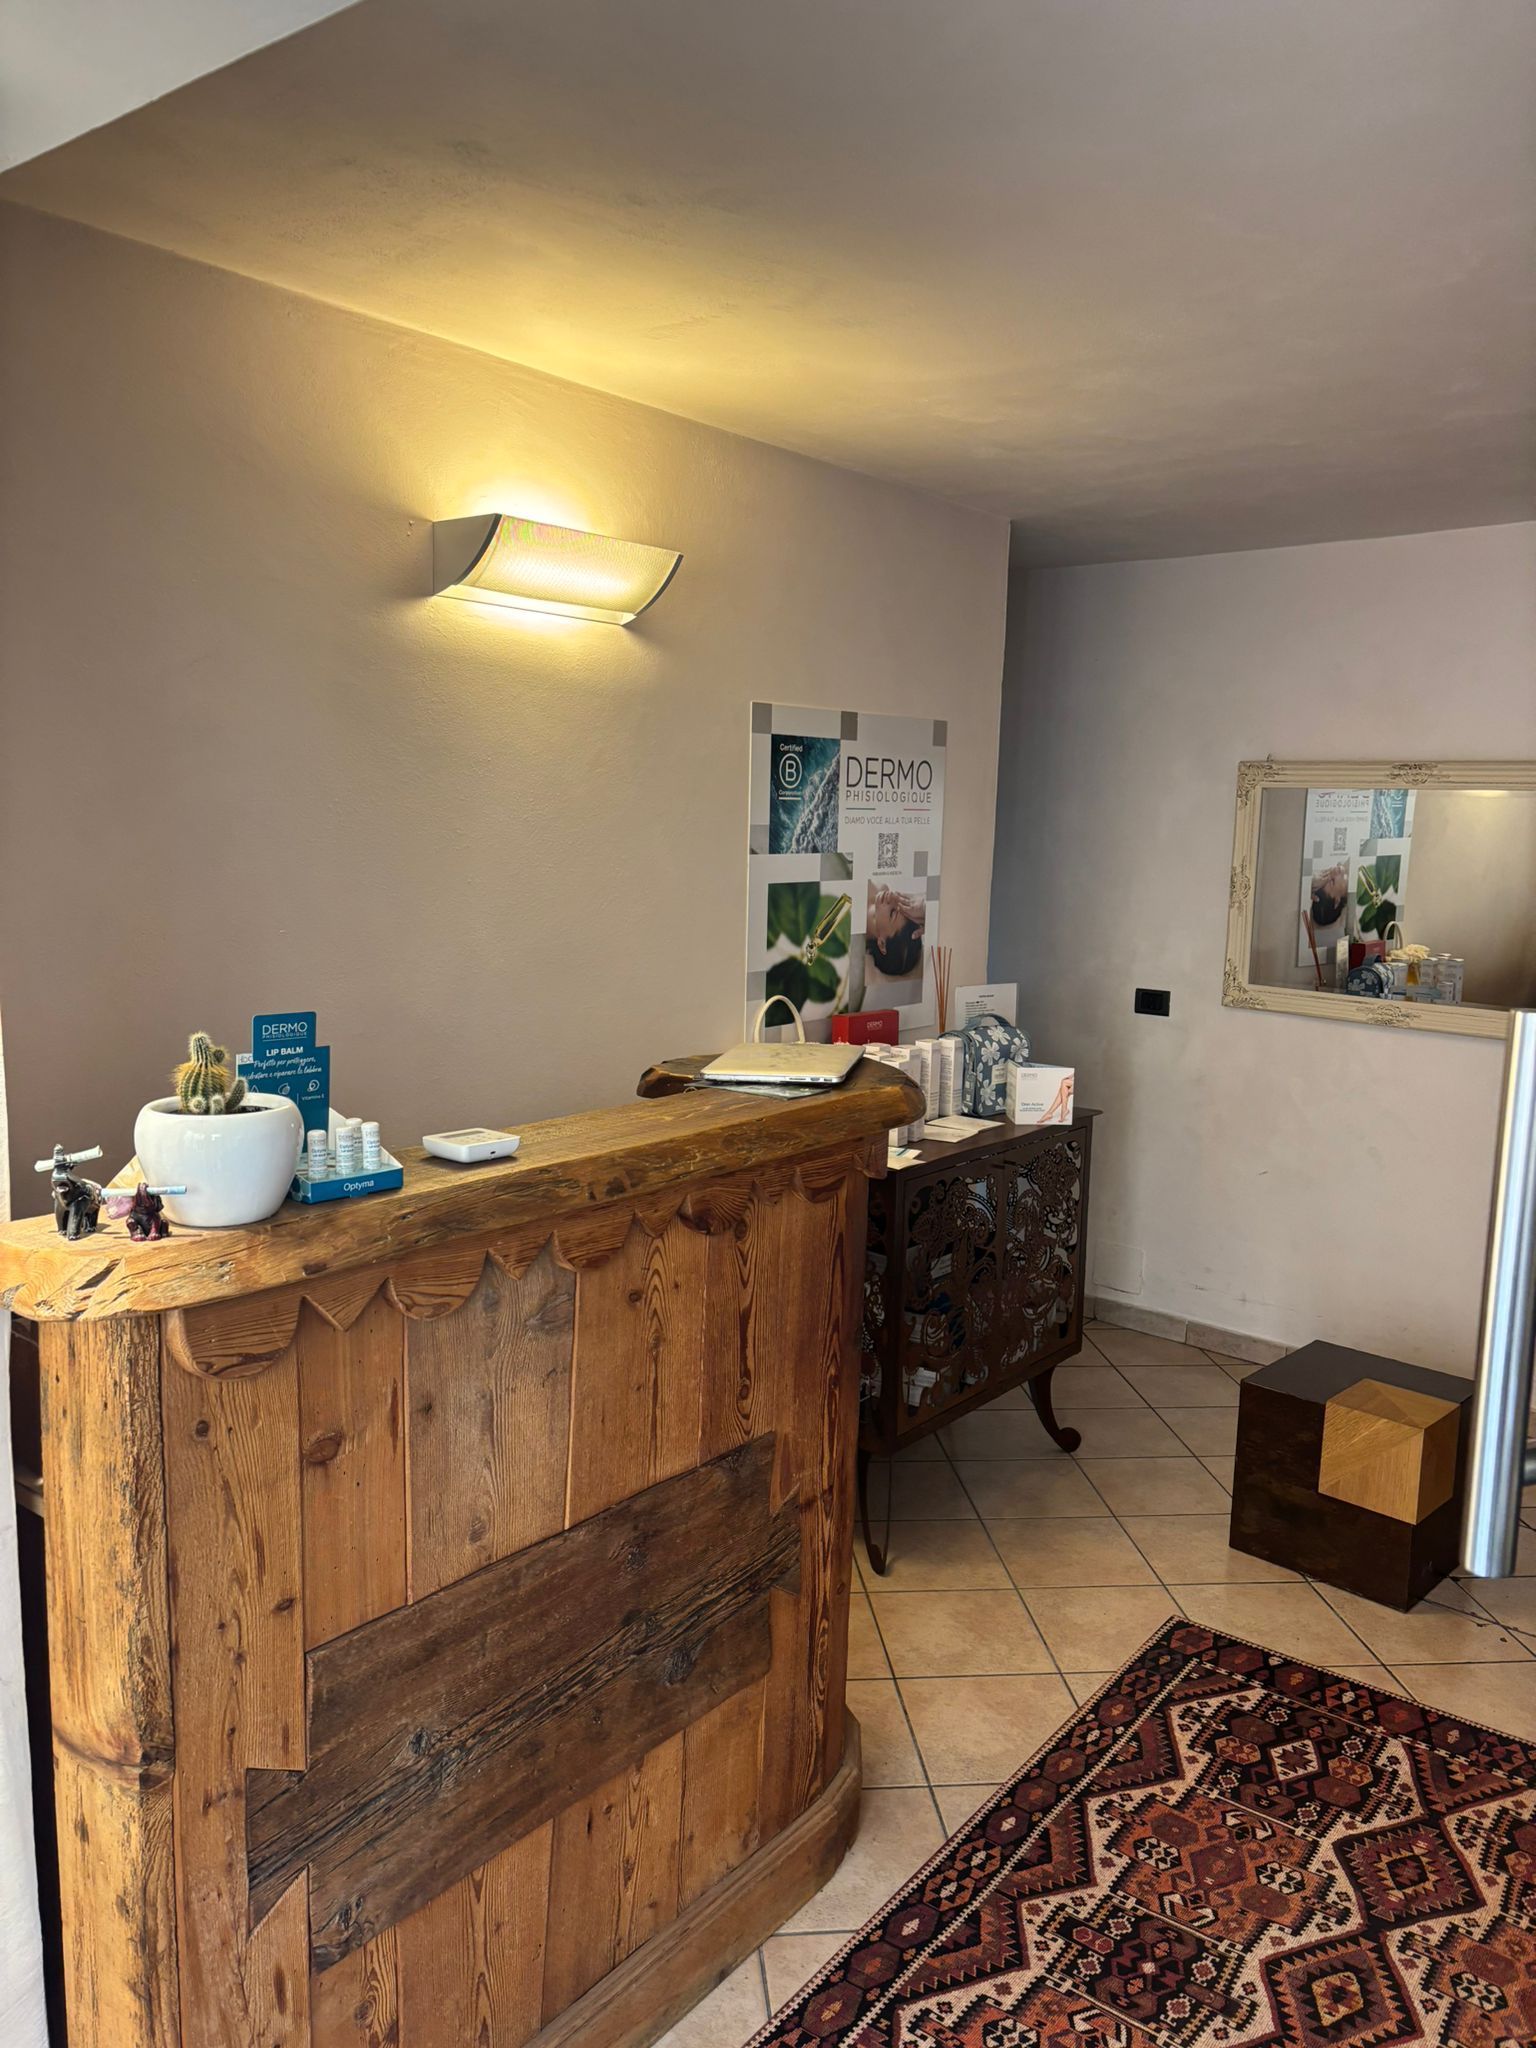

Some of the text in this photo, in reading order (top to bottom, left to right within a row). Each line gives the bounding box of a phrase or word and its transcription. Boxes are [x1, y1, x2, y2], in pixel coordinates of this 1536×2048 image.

[780, 743, 803, 752] Certified
[785, 760, 797, 781] B
[846, 756, 933, 790] DERMO
[845, 790, 932, 803] PHISIOLOGIQUE
[866, 816, 883, 825] VOCE
[884, 816, 900, 825] ALLA
[901, 816, 913, 825] TUA
[914, 816, 931, 825] PELLE
[262, 1022, 308, 1036] DERMO
[266, 1046, 304, 1057] LIP BALM
[343, 1180, 374, 1192] Optyma
